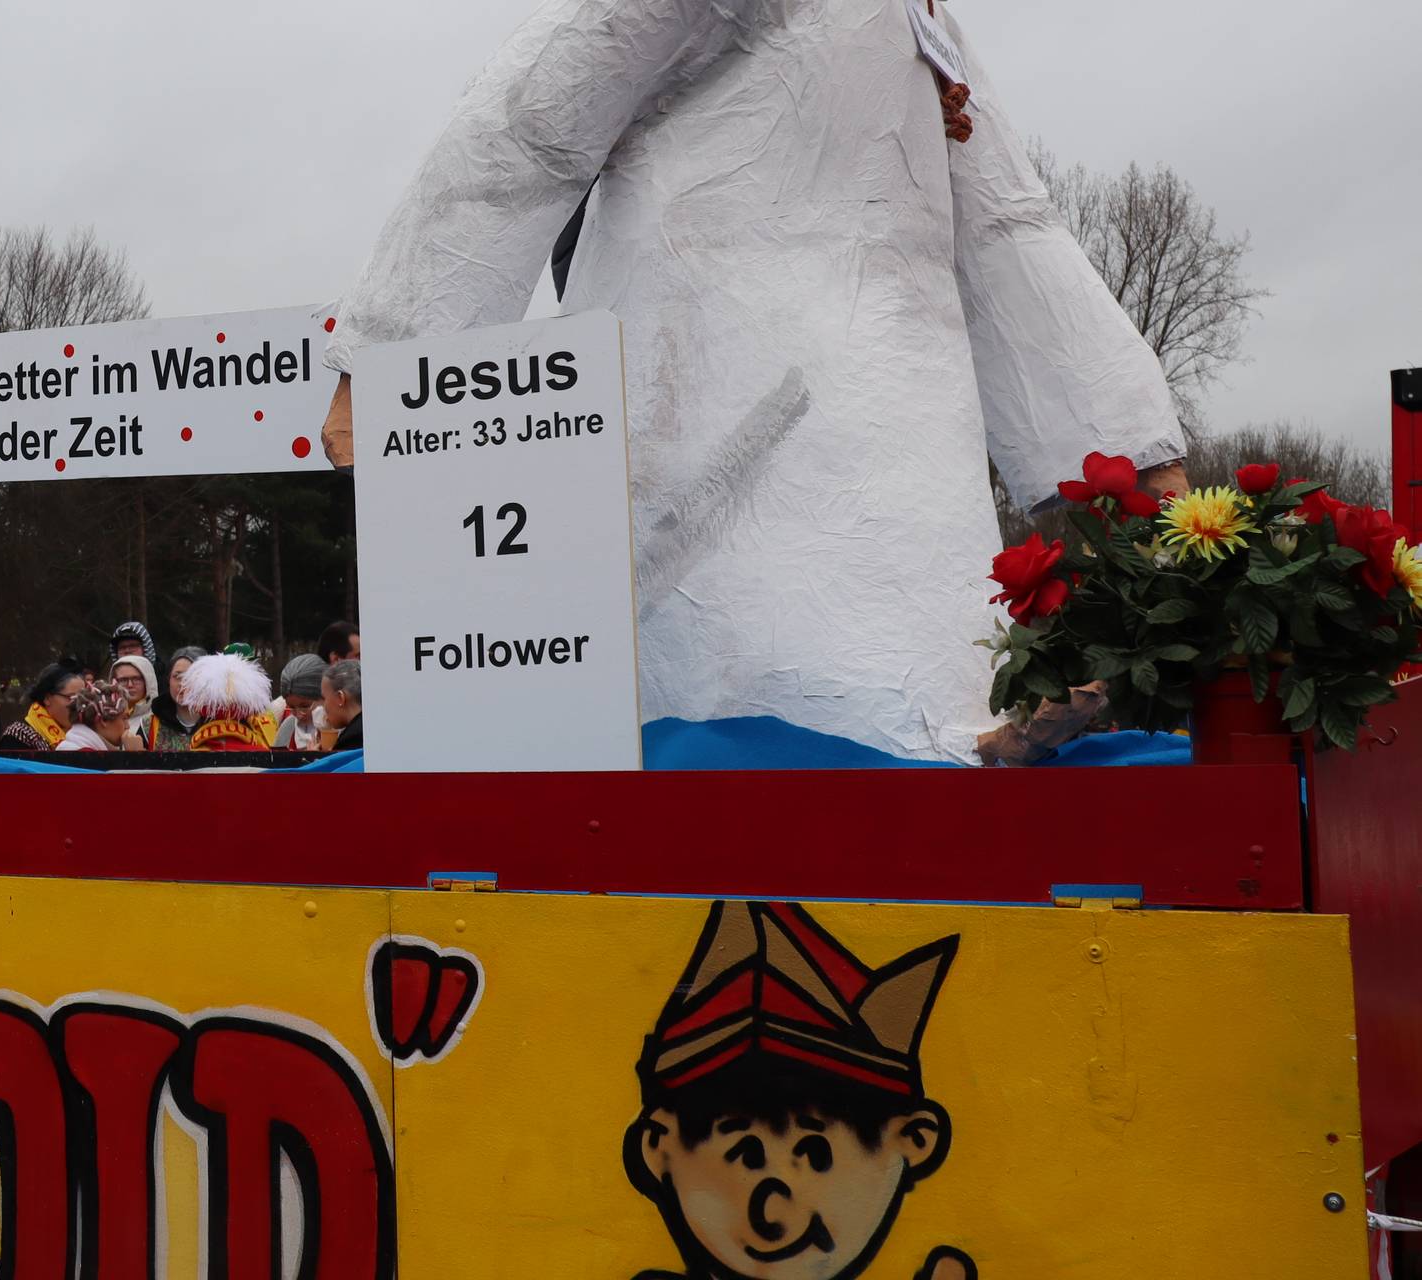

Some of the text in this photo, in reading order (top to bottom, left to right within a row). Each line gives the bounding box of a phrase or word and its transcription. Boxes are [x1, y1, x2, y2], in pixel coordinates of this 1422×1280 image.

[91, 354, 138, 395] im
[151, 337, 312, 390] Wandel
[401, 350, 578, 409] Jesus
[69, 415, 143, 459] Zeit
[383, 411, 604, 457] Alter: 33 Jahre
[462, 502, 529, 557] 12
[414, 632, 589, 671] Follower
